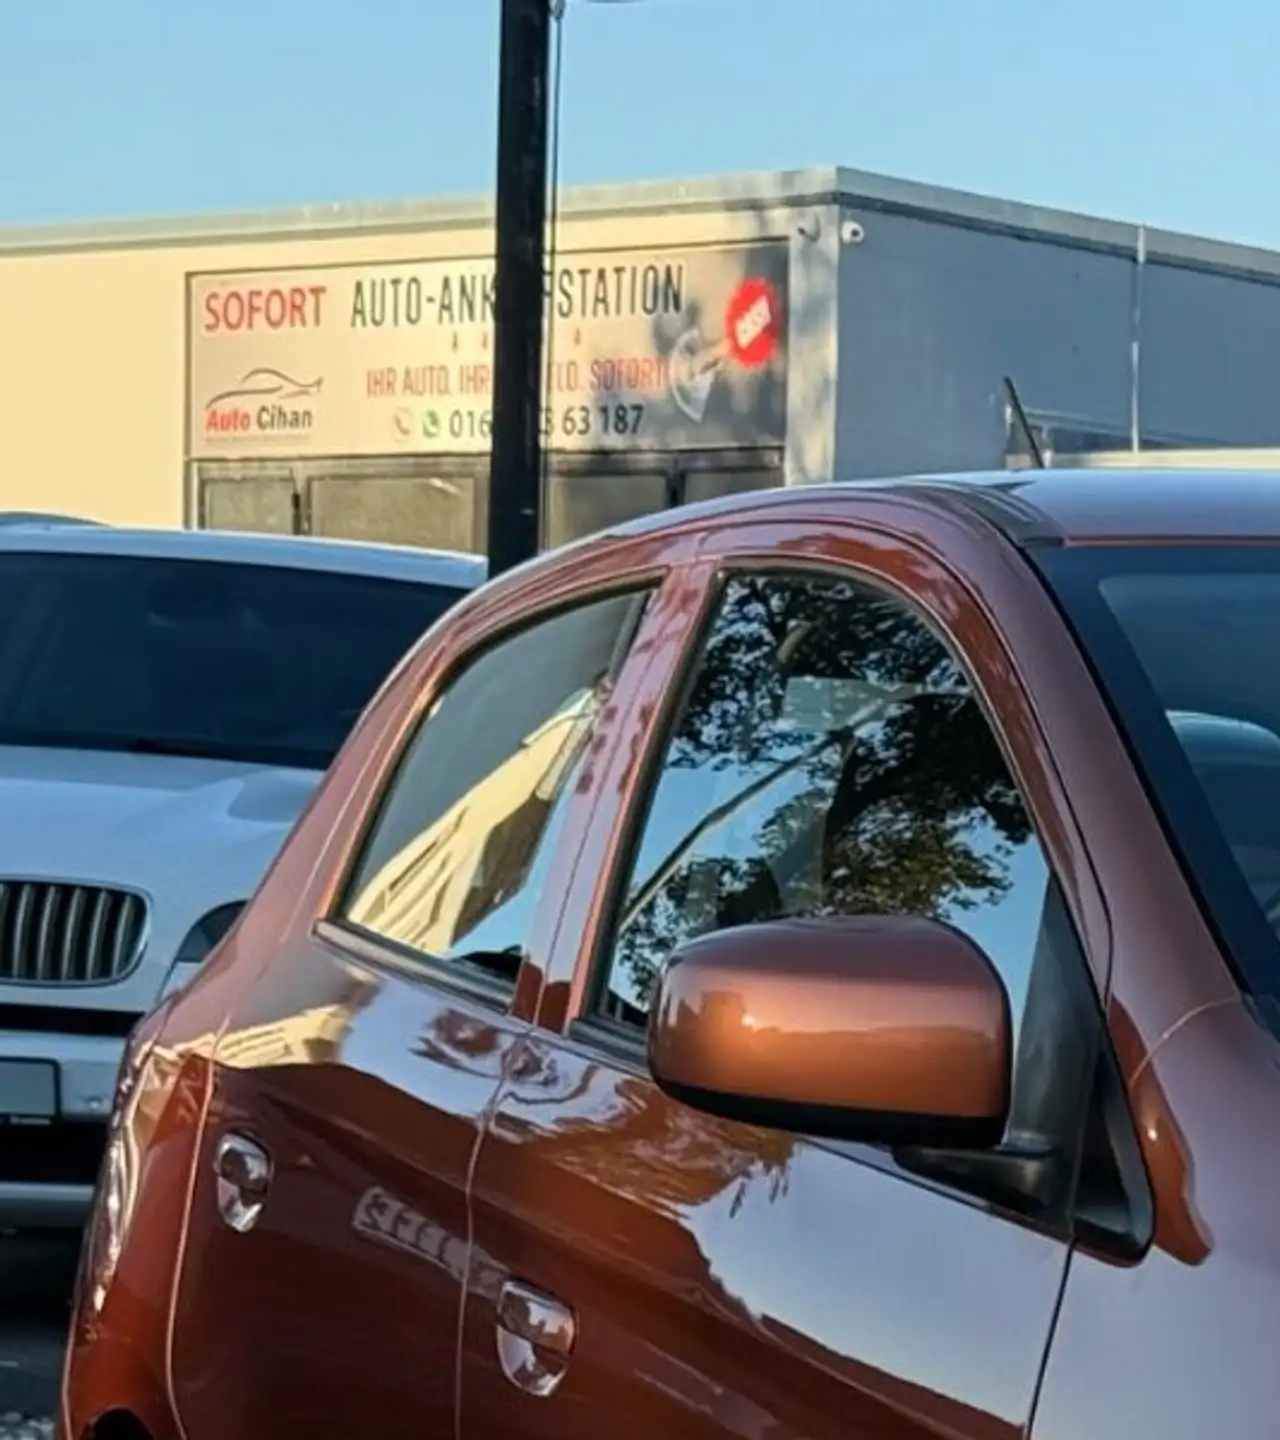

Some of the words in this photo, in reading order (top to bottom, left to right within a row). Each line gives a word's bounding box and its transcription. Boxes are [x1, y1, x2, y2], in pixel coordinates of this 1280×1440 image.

[204, 285, 328, 332] SOFORT
[366, 367, 397, 398] IHR
[205, 406, 251, 433] Auto
[256, 403, 313, 431] Cihan
[561, 404, 590, 436] 63
[599, 403, 644, 435] 187
